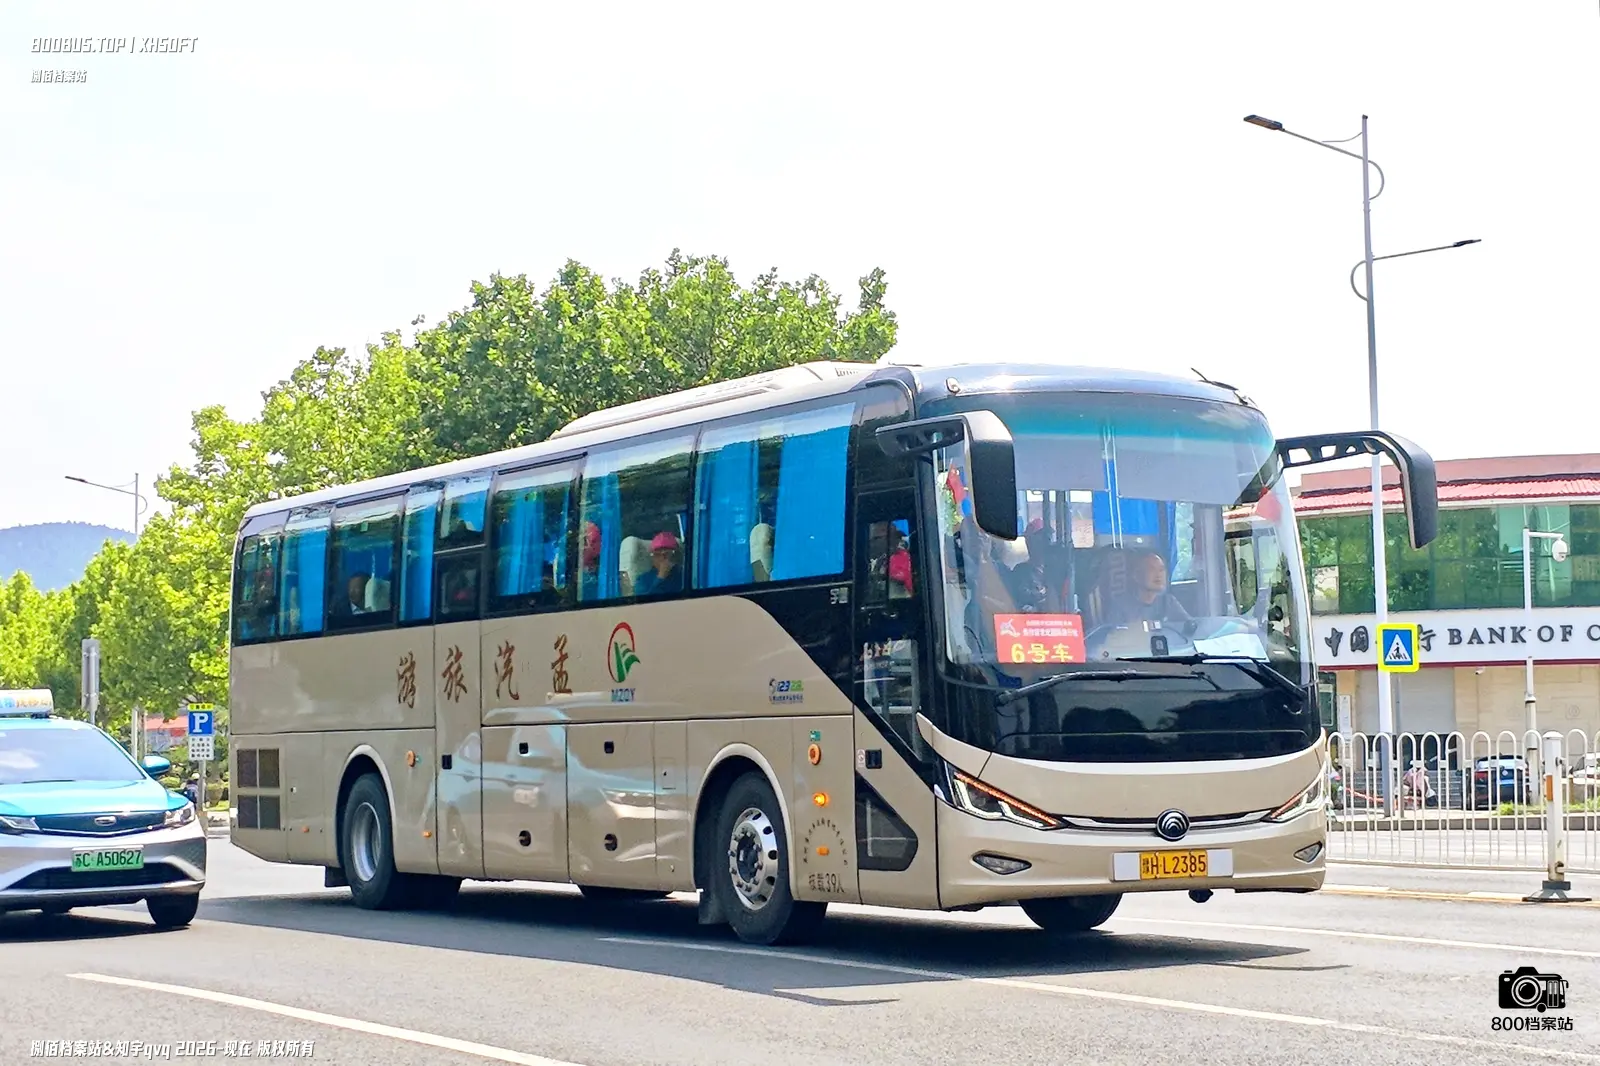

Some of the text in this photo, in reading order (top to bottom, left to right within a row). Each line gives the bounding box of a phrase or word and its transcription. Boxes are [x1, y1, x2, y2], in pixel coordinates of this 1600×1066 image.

[1324, 624, 1436, 657] 中国行
[1447, 626, 1527, 645] BANK
[1537, 624, 1573, 643] OF
[1011, 643, 1073, 663] 6号车
[192, 712, 209, 733] P
